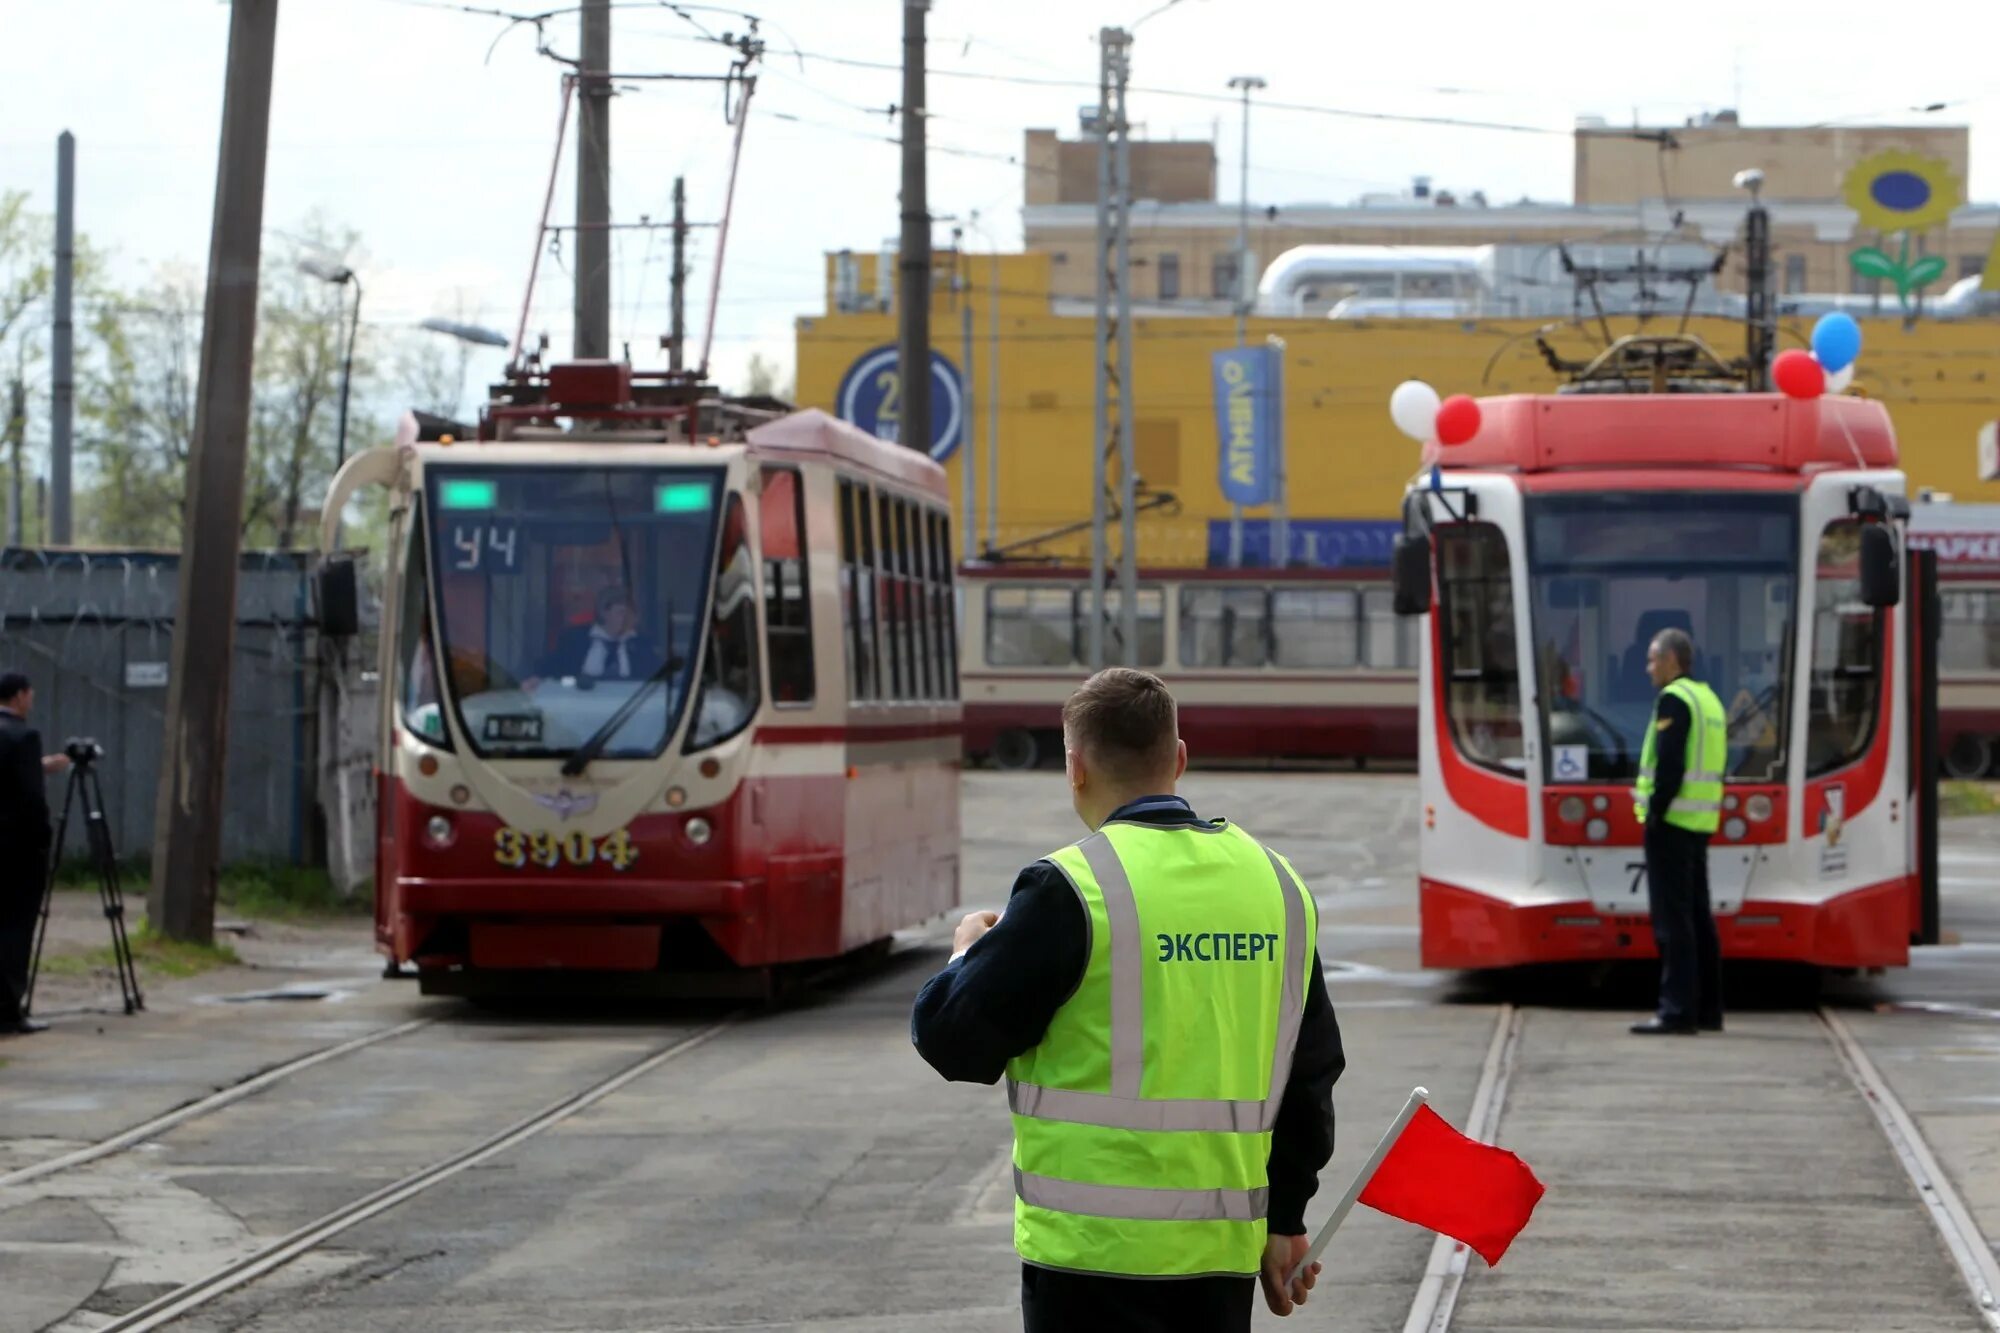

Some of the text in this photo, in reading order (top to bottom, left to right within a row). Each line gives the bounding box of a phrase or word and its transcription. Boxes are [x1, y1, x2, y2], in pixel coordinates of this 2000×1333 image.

[877, 371, 900, 420] 2
[494, 827, 638, 871] 3904
[1625, 862, 1648, 894] 7
[1157, 933, 1279, 962] ЭКСПЕРТ
